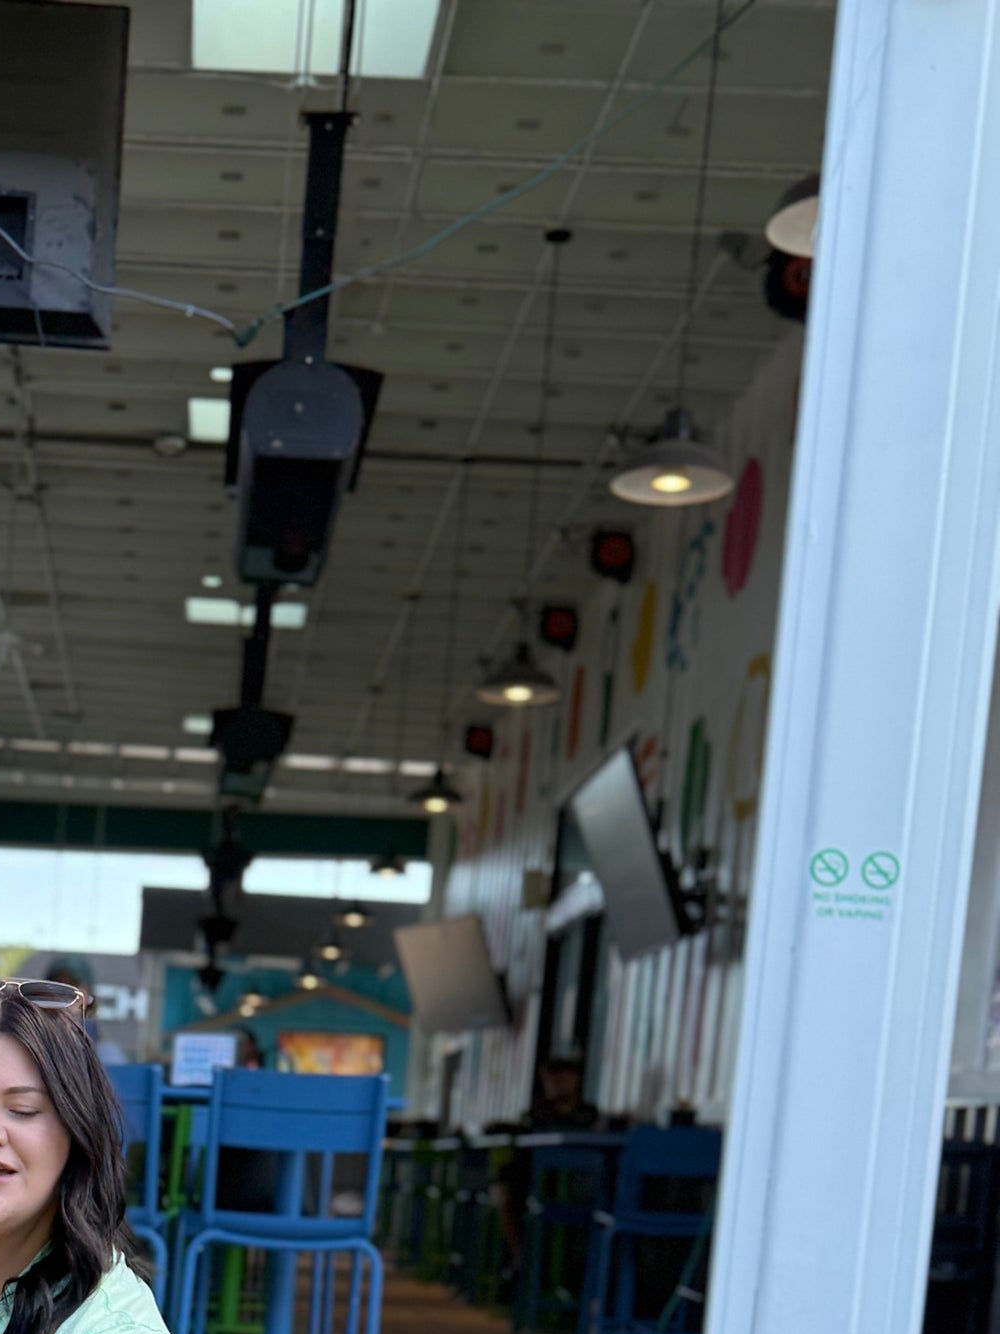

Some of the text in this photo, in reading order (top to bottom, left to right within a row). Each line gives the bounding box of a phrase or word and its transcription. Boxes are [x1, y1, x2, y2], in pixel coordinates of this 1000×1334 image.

[813, 892, 890, 906] NO SMOKING
[816, 906, 884, 920] OR VAPING
